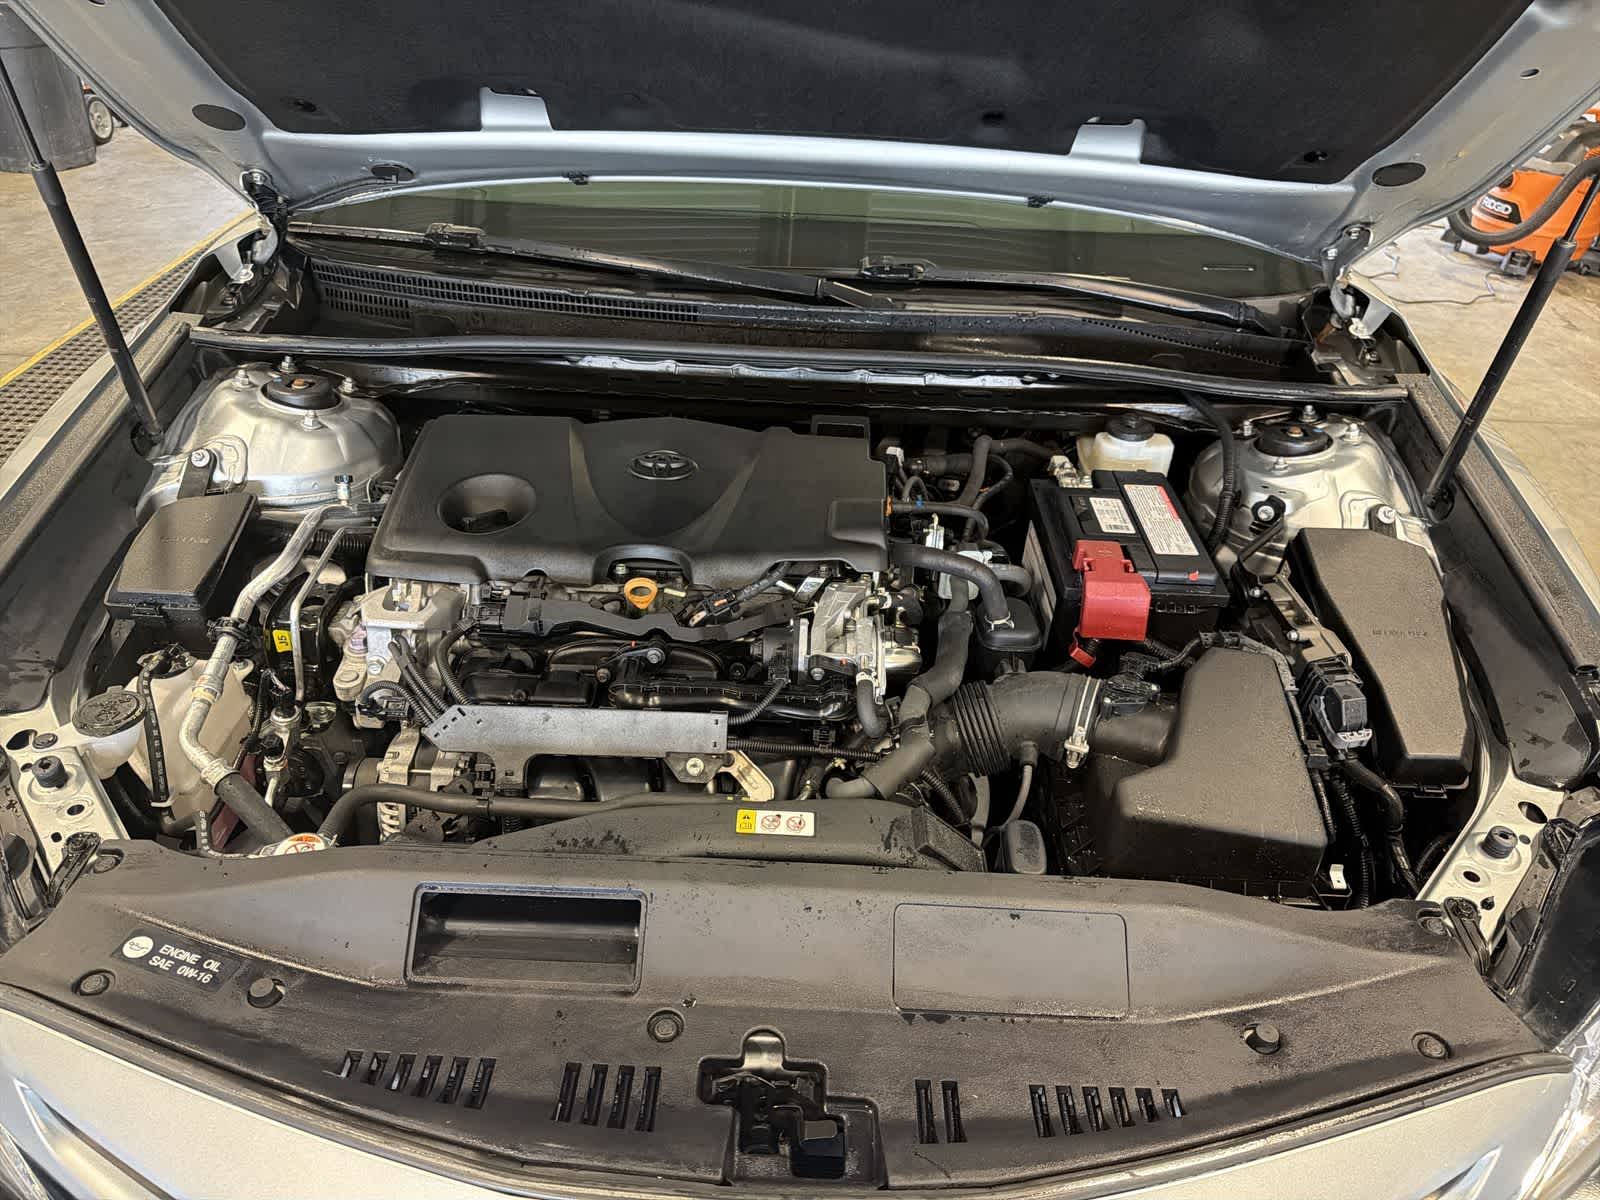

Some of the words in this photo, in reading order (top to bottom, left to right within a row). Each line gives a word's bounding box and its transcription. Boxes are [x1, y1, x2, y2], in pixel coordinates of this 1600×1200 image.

[148, 955, 175, 971] SAE
[176, 965, 213, 984] 0W-16
[159, 944, 201, 965] ENGINE
[203, 959, 223, 973] OIL
